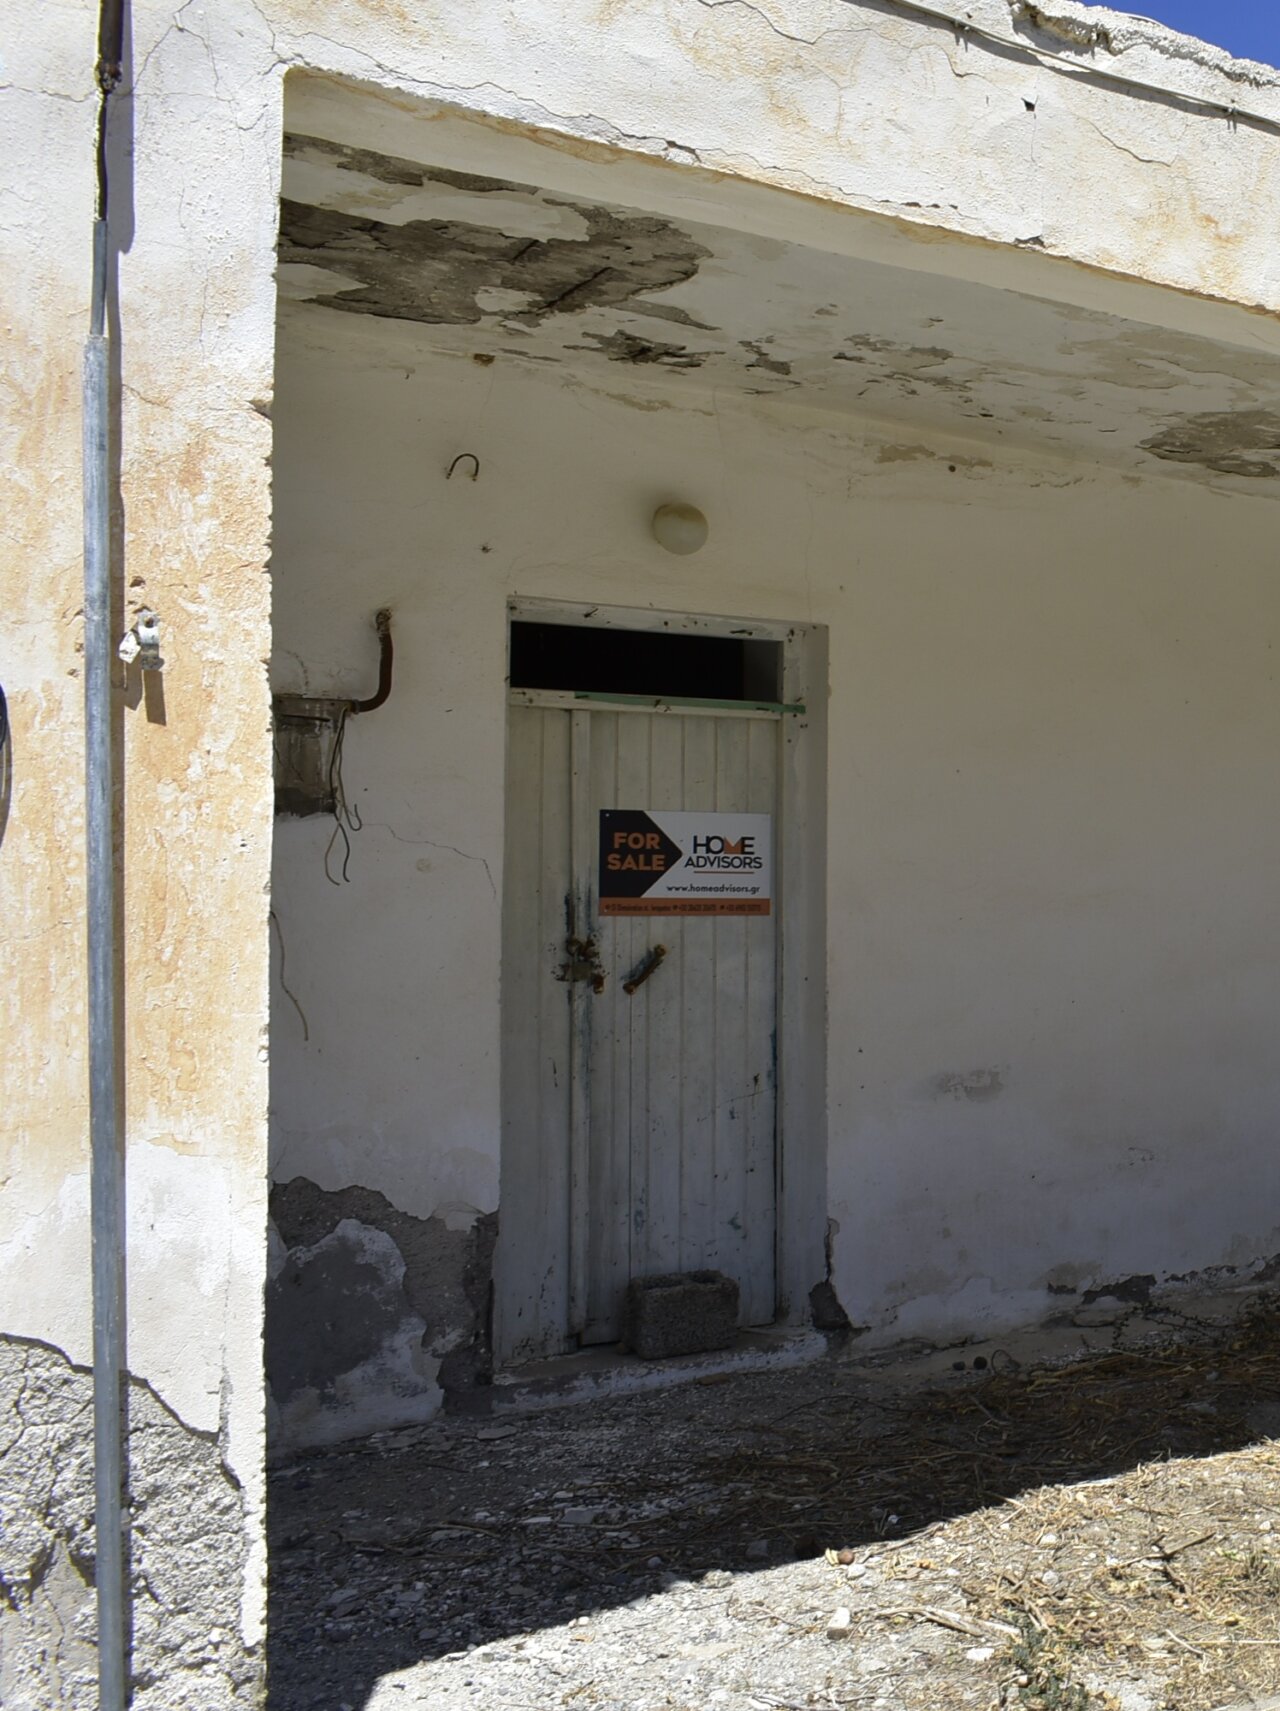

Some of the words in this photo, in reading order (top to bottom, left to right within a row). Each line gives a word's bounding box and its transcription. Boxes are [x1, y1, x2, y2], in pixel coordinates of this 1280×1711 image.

[614, 832, 661, 849] FOR
[693, 835, 755, 855] HOME
[607, 854, 665, 871] SALE
[684, 856, 763, 869] ADVISORS
[666, 884, 760, 895] www.homeadvisors.gr
